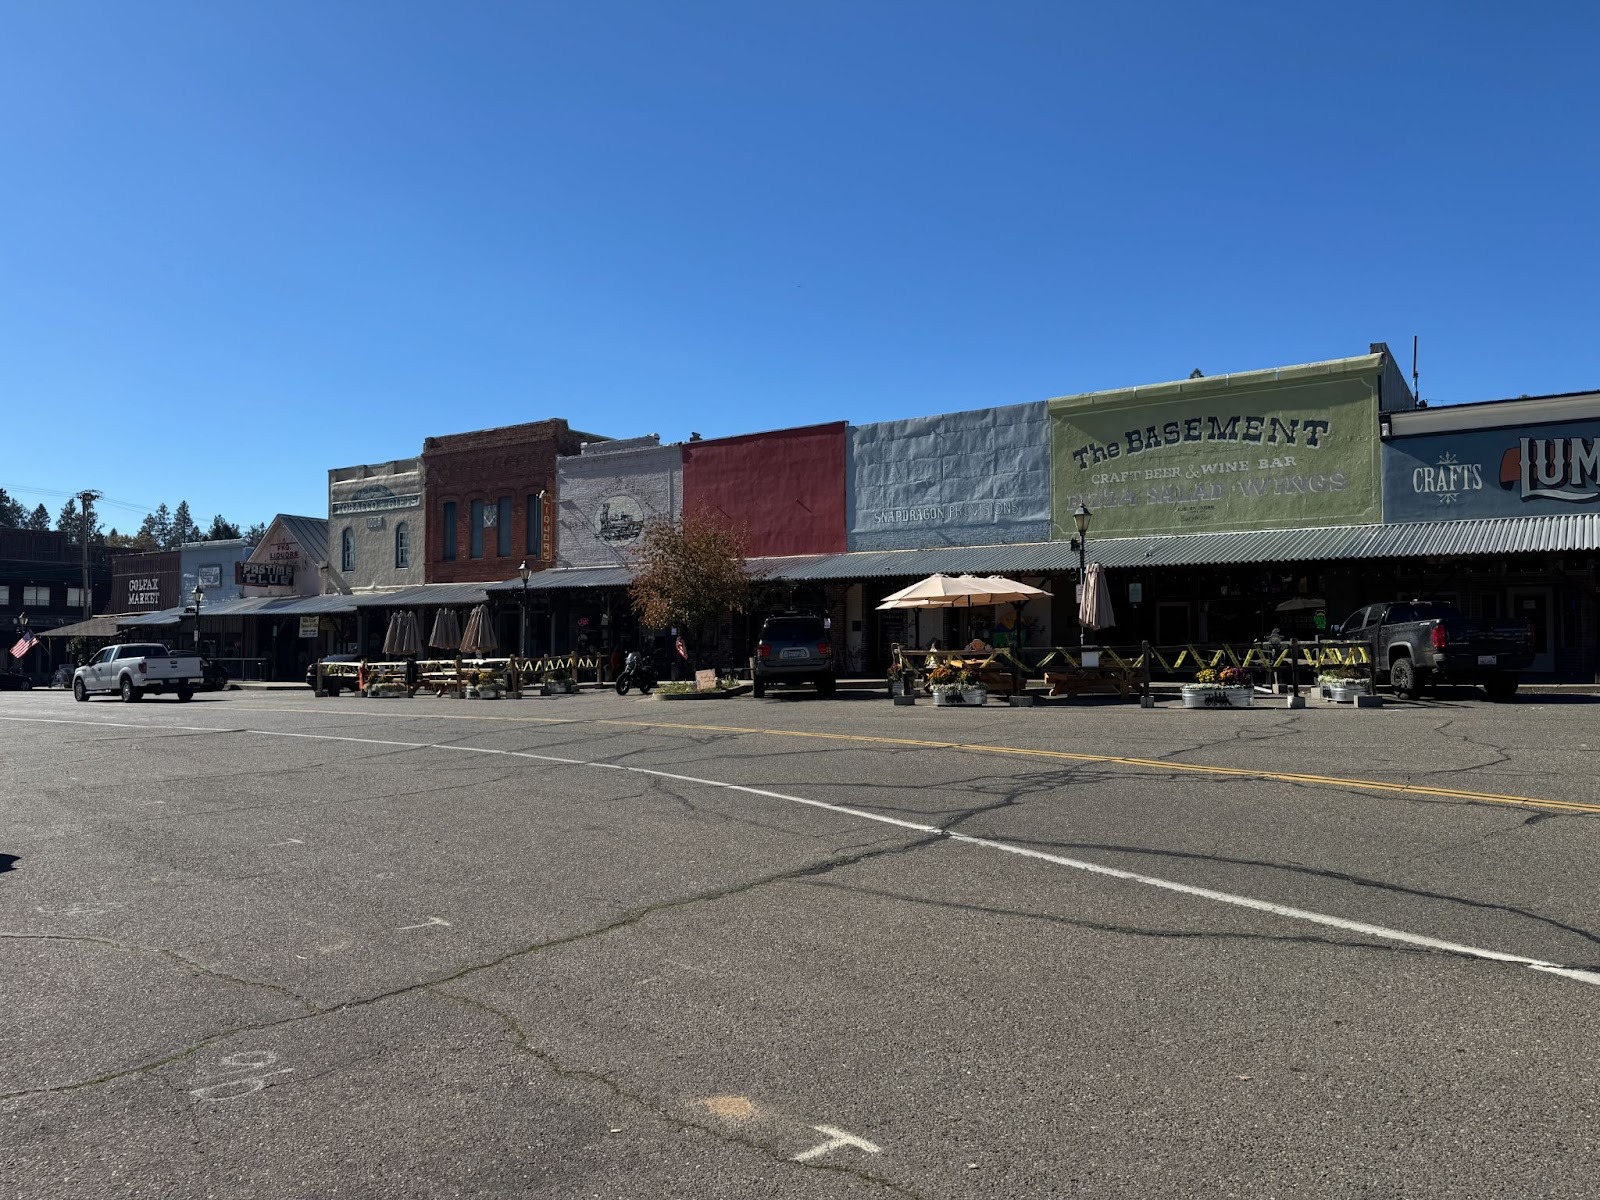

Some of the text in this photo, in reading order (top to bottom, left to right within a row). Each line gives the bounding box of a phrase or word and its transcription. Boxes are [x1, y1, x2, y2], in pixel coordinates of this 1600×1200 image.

[1073, 416, 1329, 471] The BASEMENT
[1091, 456, 1297, 485] CRAFT BEER & WINE BAR
[1412, 464, 1483, 493] CRAFTS
[1519, 437, 1600, 500] LUM
[1146, 480, 1224, 505] SALAD
[1238, 471, 1347, 498] WINGS
[337, 500, 377, 514] TOBACCO
[874, 501, 1019, 524] SNAPDRAGON PROVISIONS
[270, 551, 298, 559] LIQUORS
[243, 563, 293, 575] PASTIME
[128, 579, 159, 591] COLFAX
[128, 592, 160, 604] MARKET
